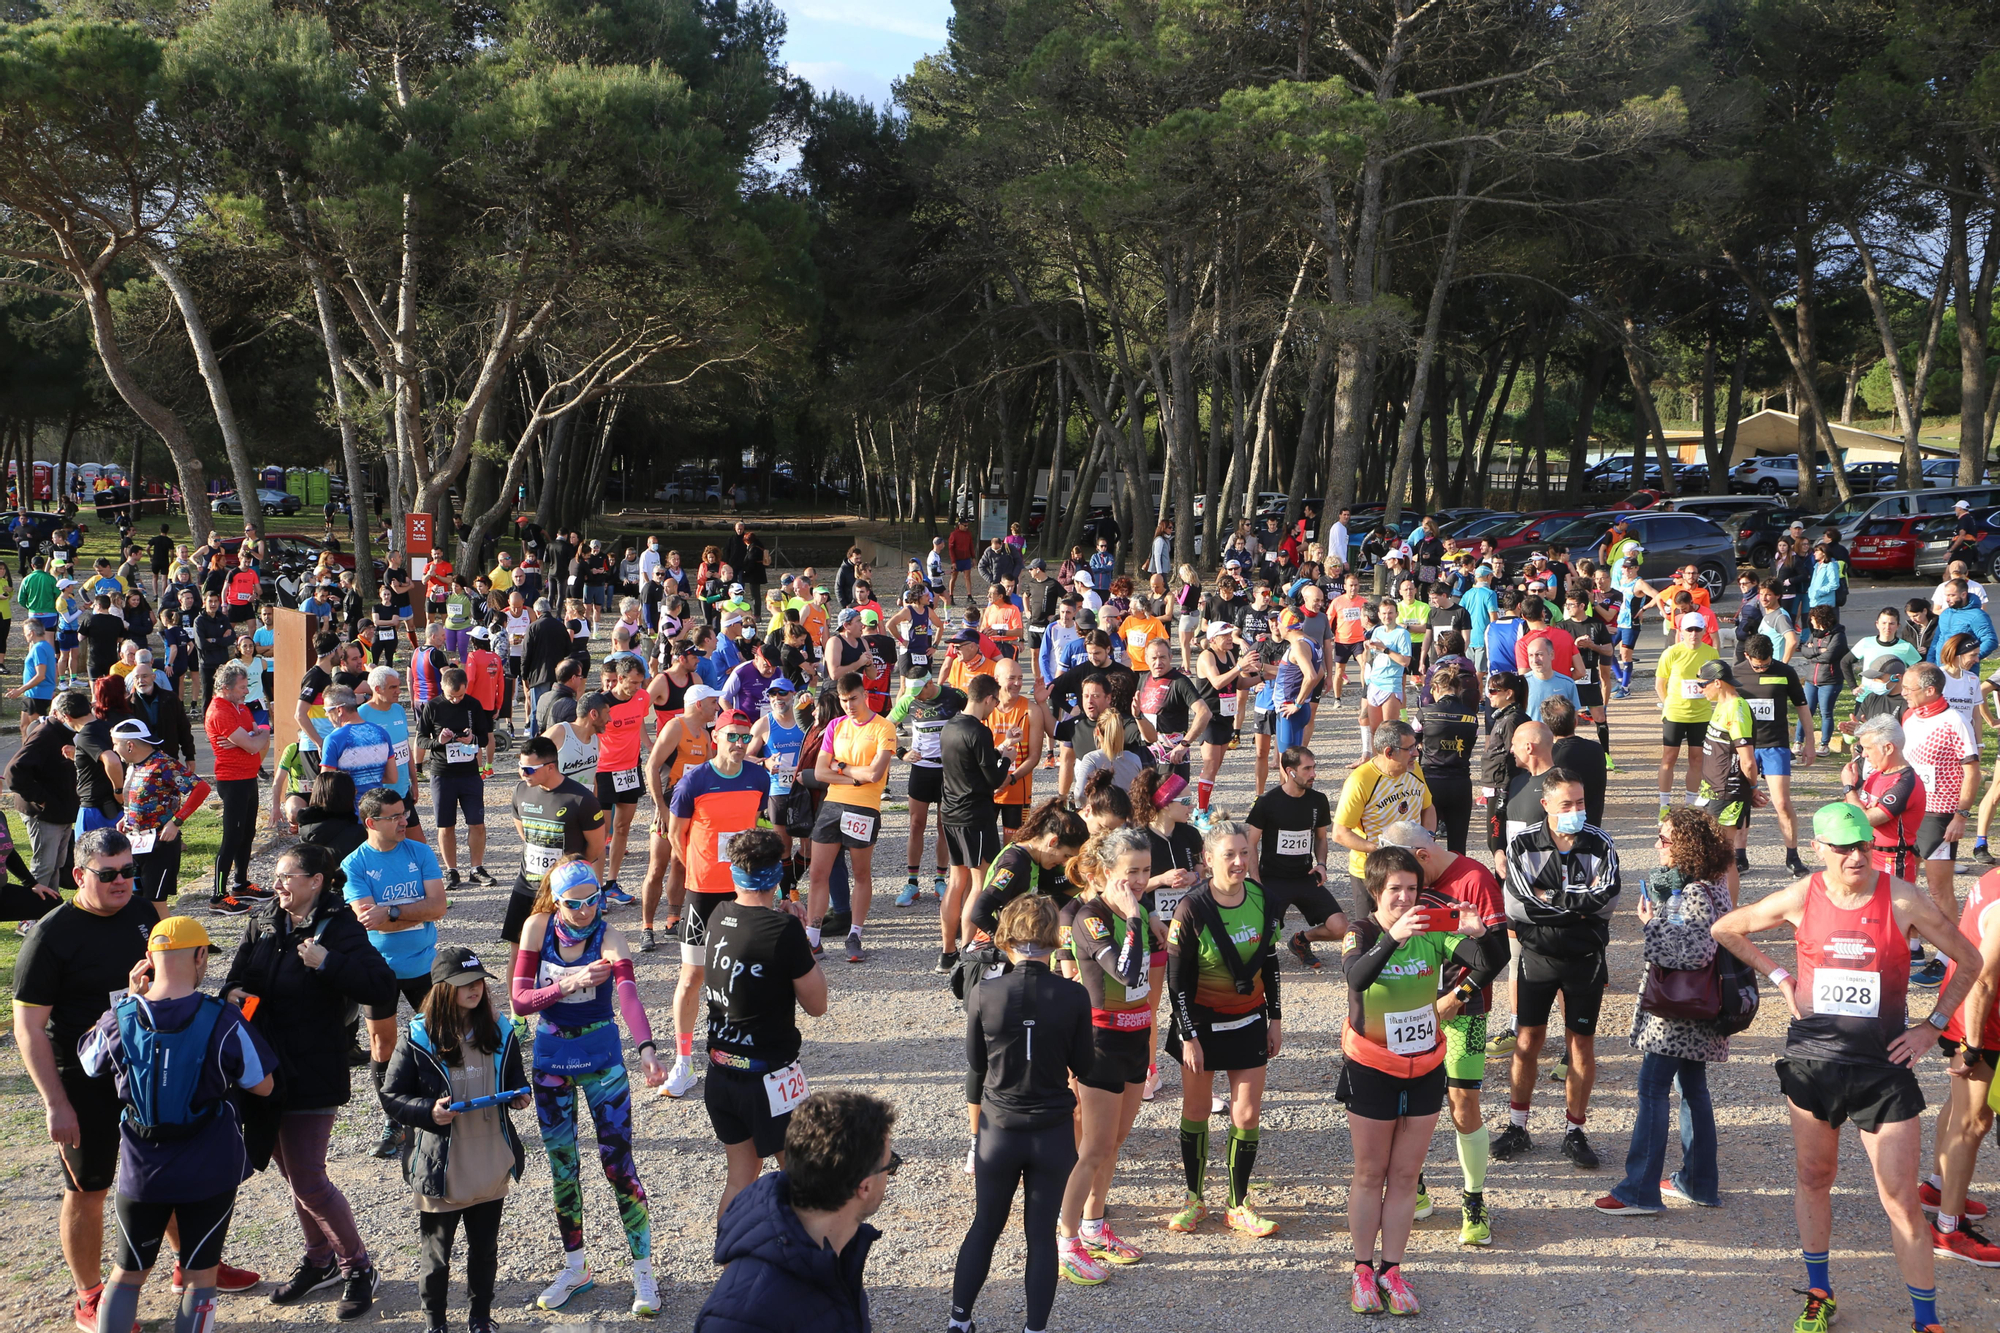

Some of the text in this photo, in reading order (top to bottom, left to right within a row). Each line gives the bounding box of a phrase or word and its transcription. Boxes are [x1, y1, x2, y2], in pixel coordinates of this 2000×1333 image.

[522, 820, 565, 832] BARCELONA
[847, 820, 867, 835] 162
[1281, 839, 1308, 849] 2216
[530, 855, 558, 868] 2182
[382, 881, 419, 901] 42K
[712, 935, 764, 993] tope
[1820, 985, 1871, 1005] 2028
[1116, 1018, 1146, 1027] SPORT
[1394, 1020, 1434, 1043] 1254
[551, 1061, 592, 1070] SALOMON
[778, 1073, 804, 1102] 129
